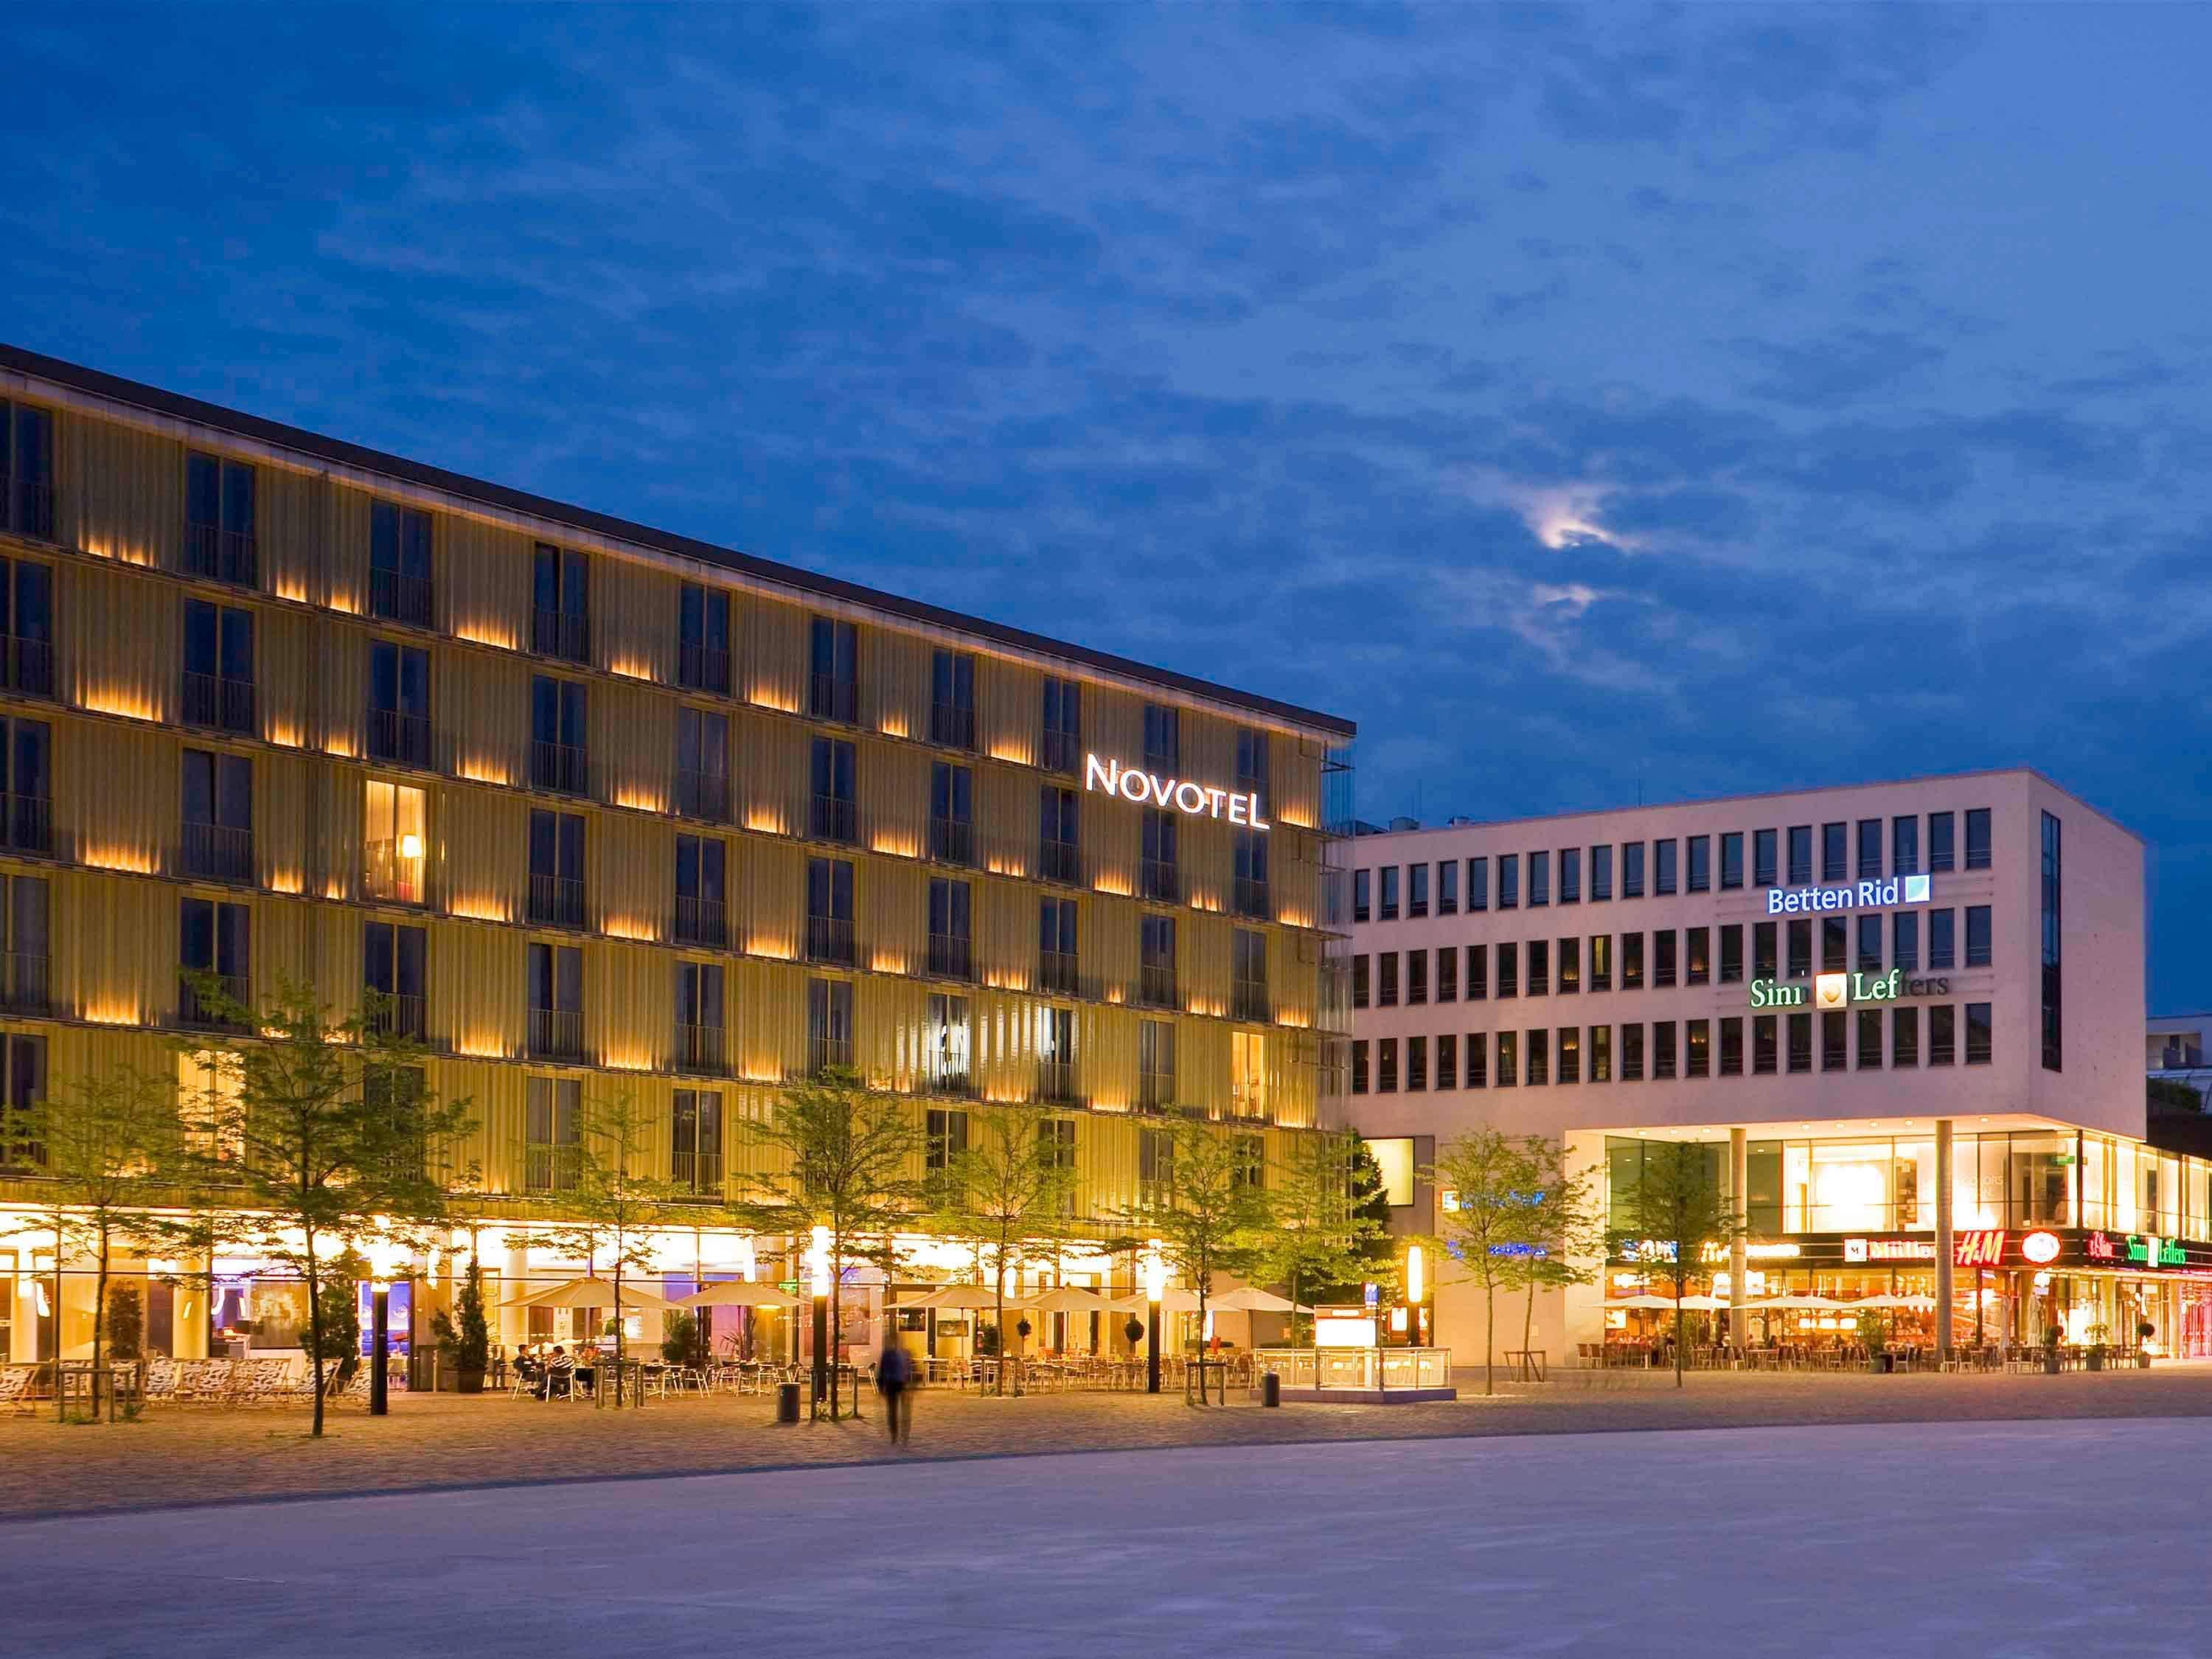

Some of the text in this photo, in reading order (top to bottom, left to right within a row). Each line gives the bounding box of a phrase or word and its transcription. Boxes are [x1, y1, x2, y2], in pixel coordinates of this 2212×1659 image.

[1085, 752, 1270, 830] NOVOTEL
[1768, 877, 1899, 914] Betten Rid
[1957, 1231, 2005, 1265] H&M
